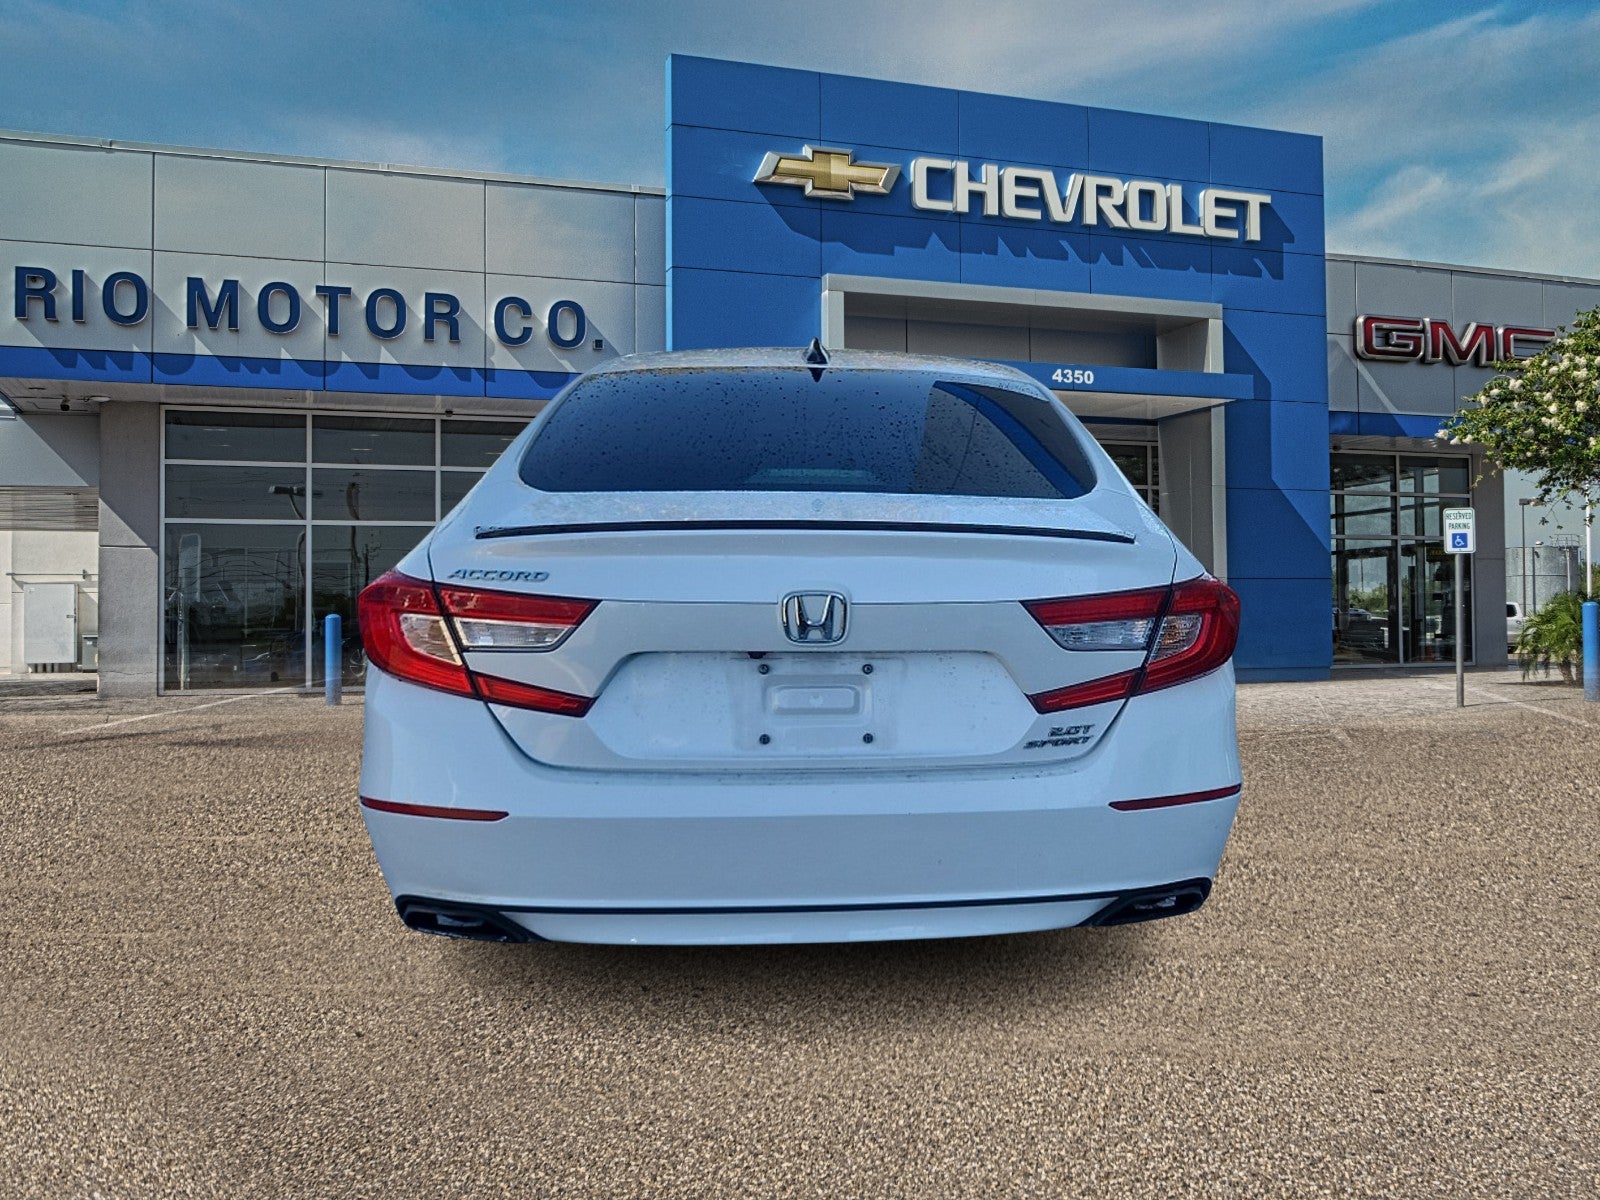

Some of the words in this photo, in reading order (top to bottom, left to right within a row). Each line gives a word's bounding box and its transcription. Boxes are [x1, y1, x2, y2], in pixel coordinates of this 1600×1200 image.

[911, 157, 1272, 242] CHEVROLET
[14, 265, 150, 327] RIO
[186, 276, 461, 343] MOTOR
[493, 295, 604, 350] CO.
[1354, 314, 1557, 367] GMC
[1051, 368, 1095, 385] 4350
[1445, 512, 1472, 520] RESERVED
[447, 569, 550, 582] ACCORD
[1022, 735, 1094, 749] SPORT
